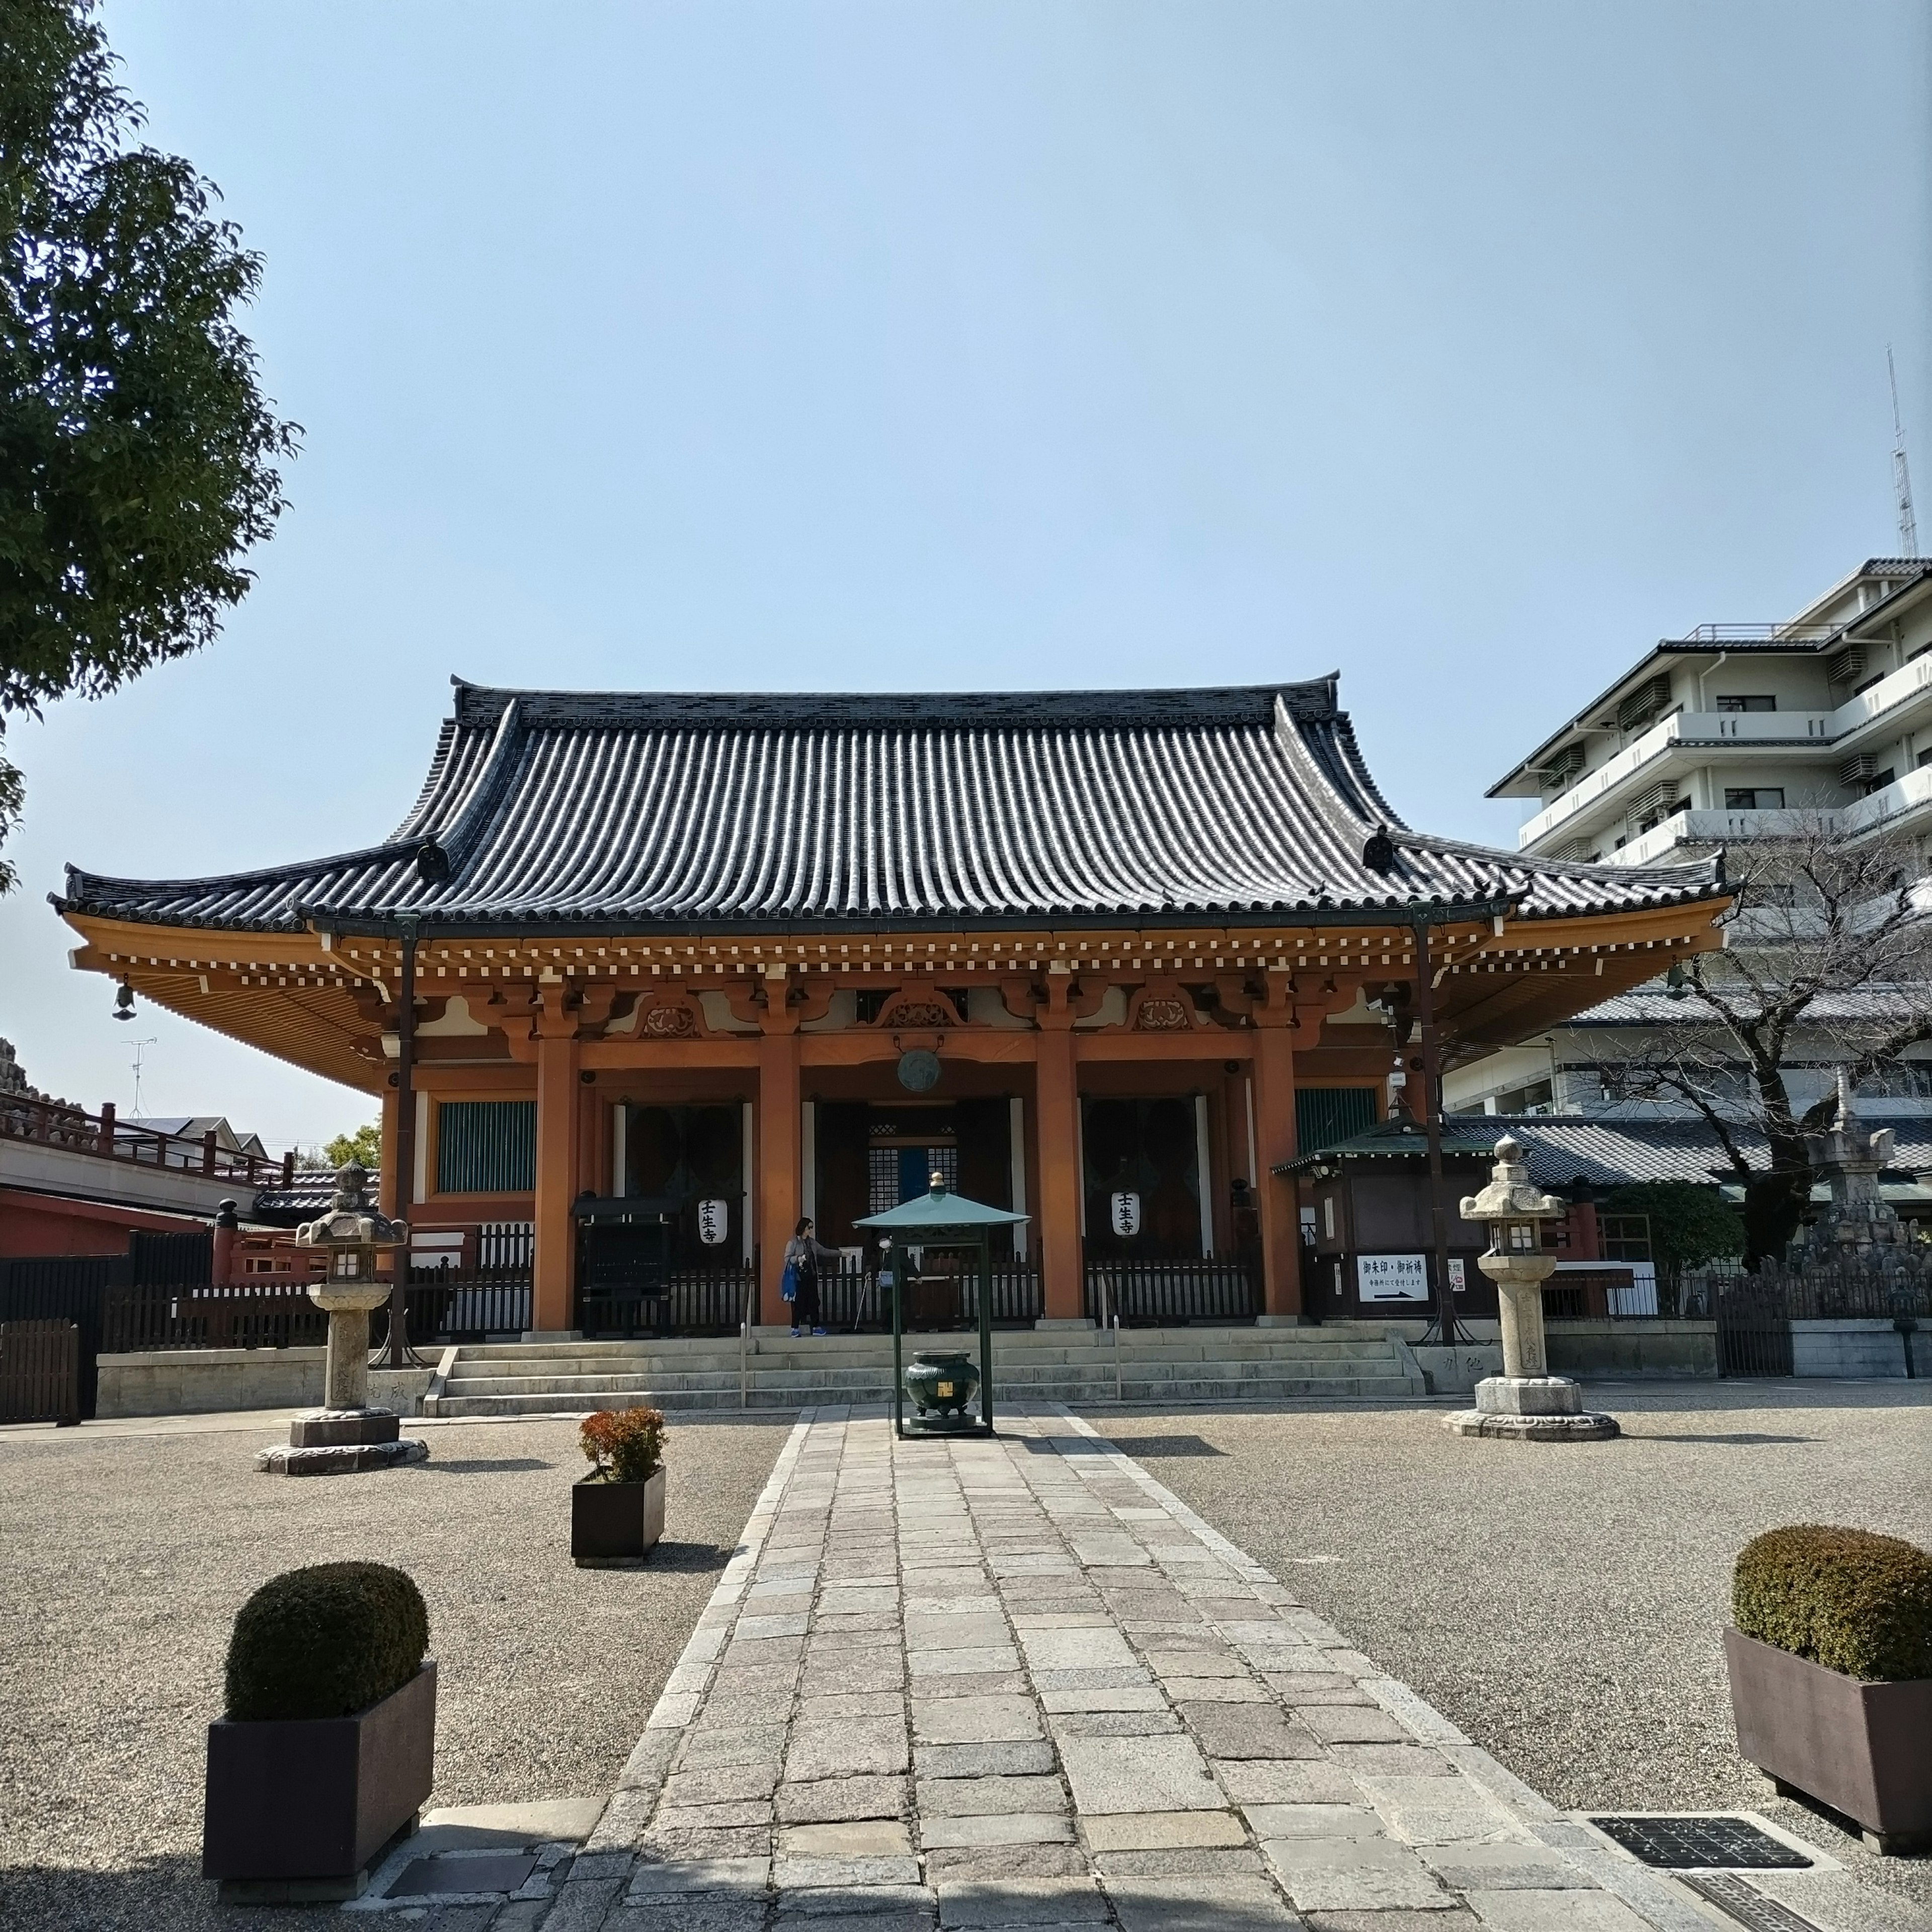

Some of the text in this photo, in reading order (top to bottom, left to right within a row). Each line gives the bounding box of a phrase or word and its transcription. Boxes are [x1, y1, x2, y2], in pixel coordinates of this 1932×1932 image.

[701, 1200, 716, 1242] 壬生寺
[1117, 1192, 1134, 1234] 壬生寺
[1363, 1259, 1422, 1275] 御朱印・御祈祷
